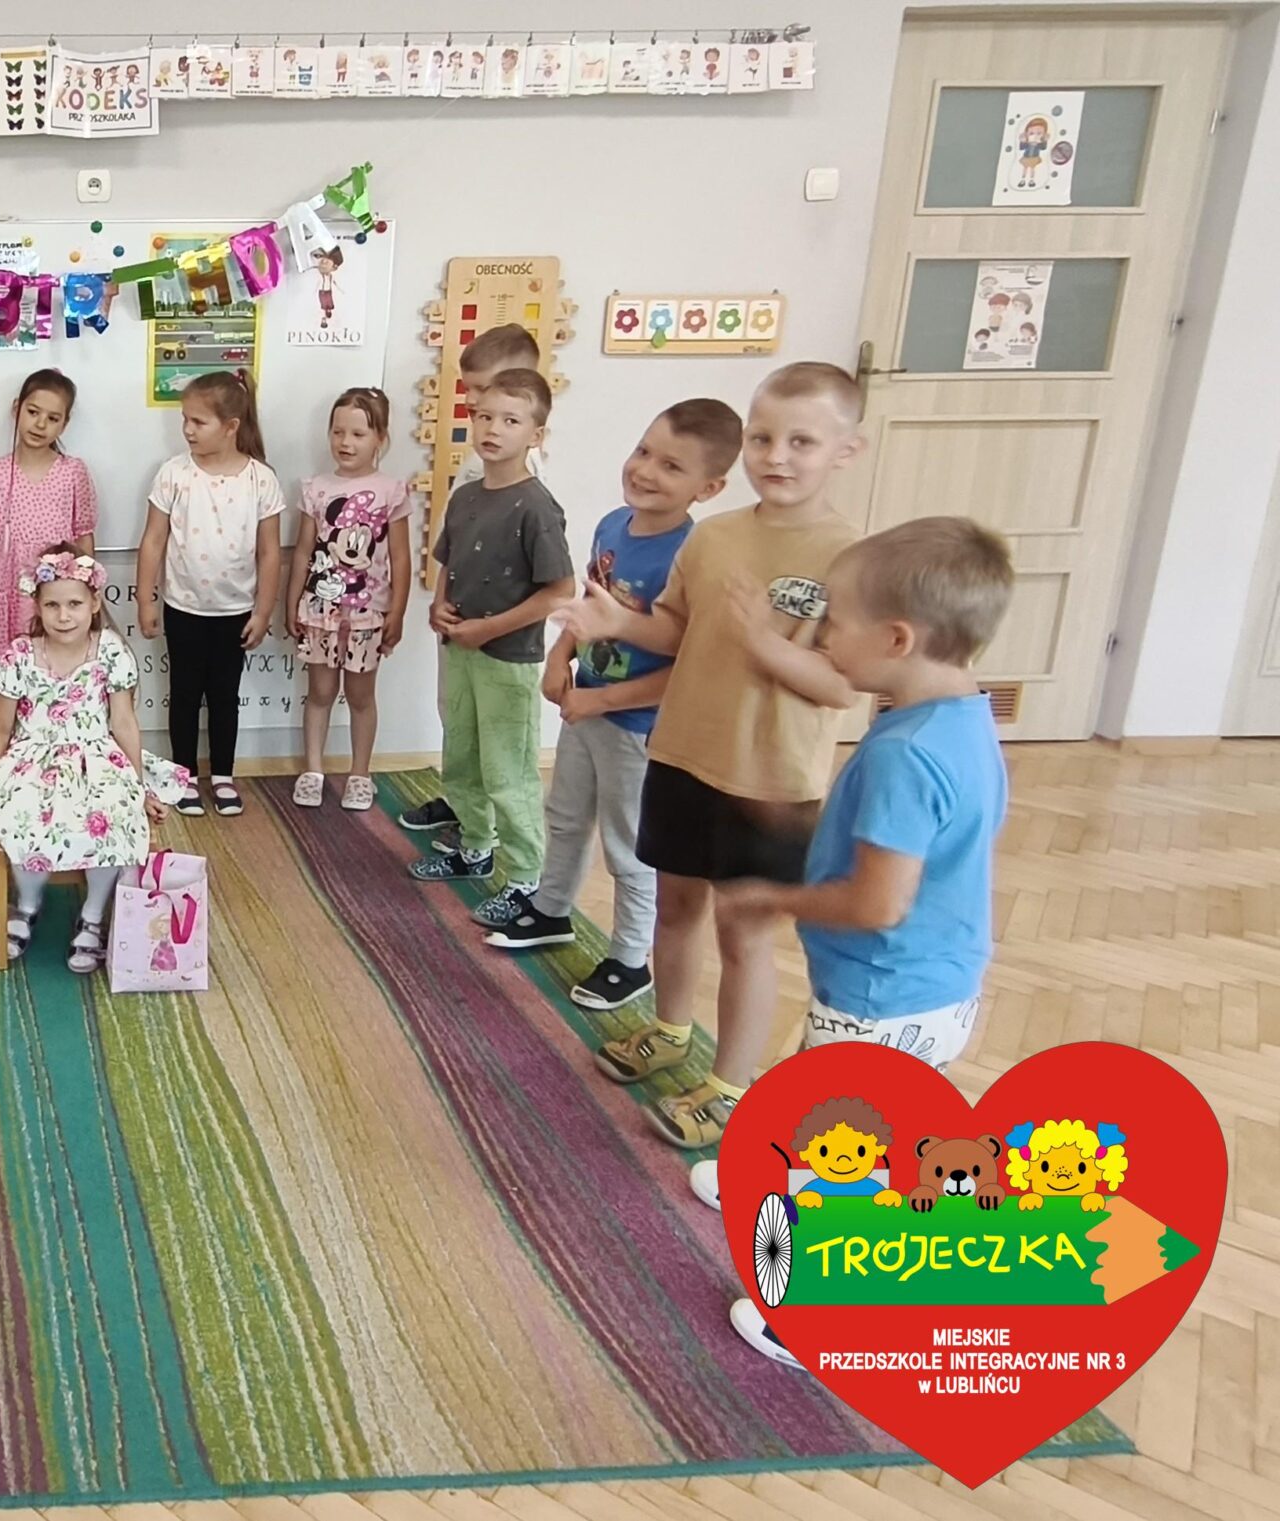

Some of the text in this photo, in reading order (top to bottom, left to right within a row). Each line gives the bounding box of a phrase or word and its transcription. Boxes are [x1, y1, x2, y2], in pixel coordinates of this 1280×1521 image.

[55, 88, 148, 111] KODEKS
[68, 112, 136, 123] PRZSZKOLAKA
[475, 261, 534, 275] OBECNOŚĆ
[287, 327, 361, 343] PINOKIO
[104, 584, 120, 606] Q
